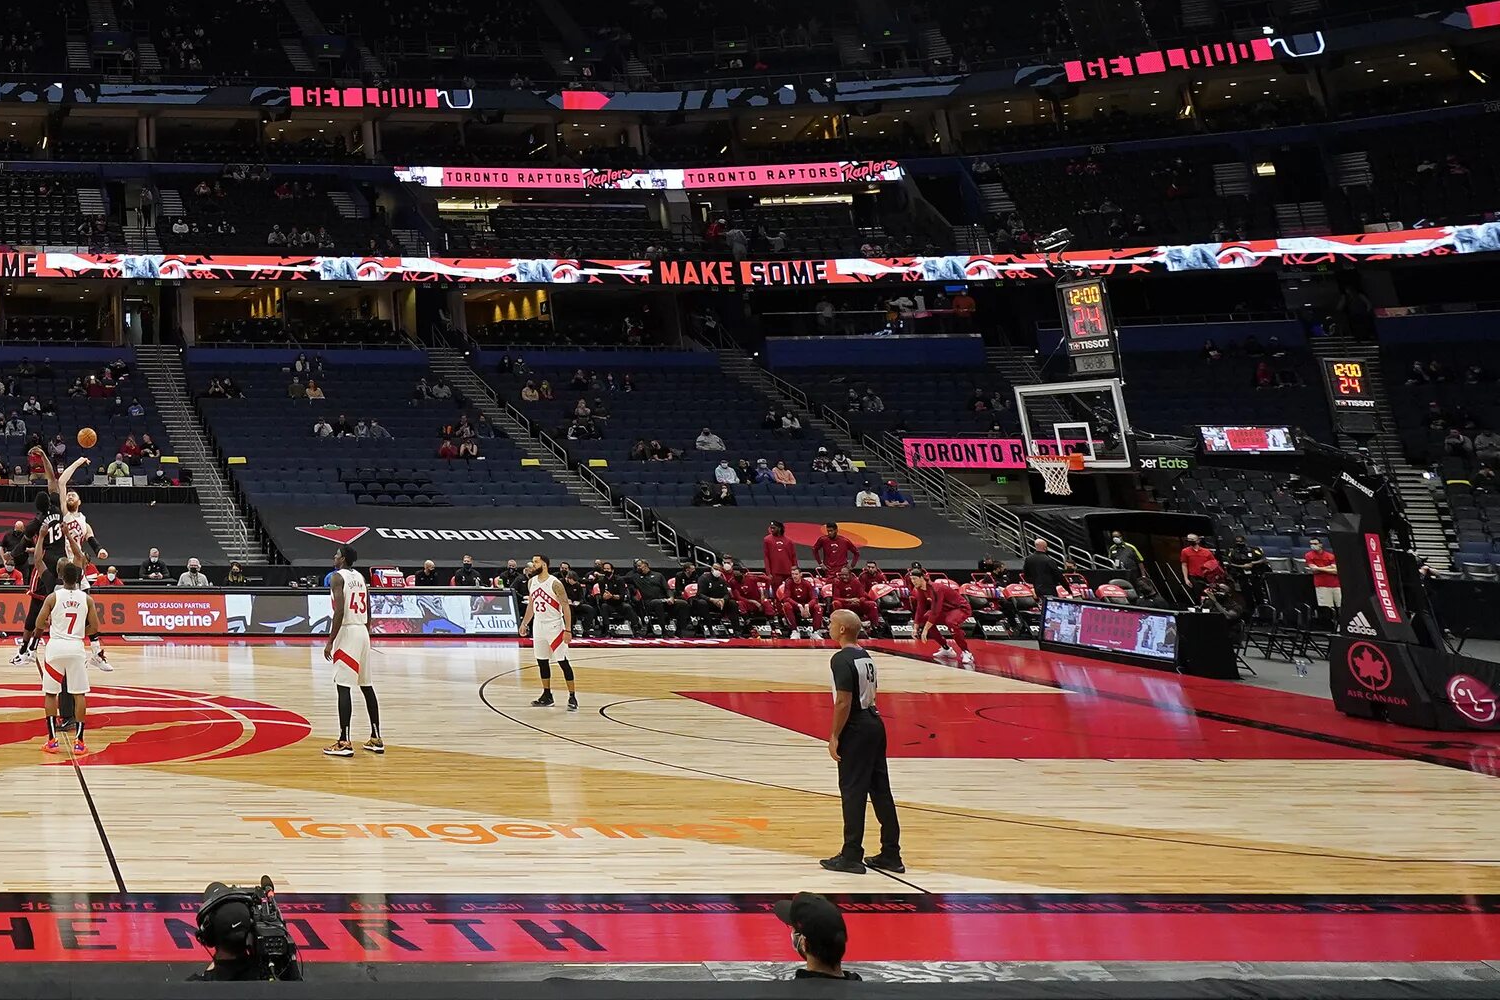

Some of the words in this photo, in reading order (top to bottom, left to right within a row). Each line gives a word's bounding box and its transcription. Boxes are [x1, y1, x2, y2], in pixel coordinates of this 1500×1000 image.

[1082, 55, 1139, 81] GET
[1163, 40, 1256, 70] LOUD
[302, 87, 345, 107] GET
[363, 88, 426, 108] LOUD
[1090, 145, 1106, 155] 205
[445, 172, 509, 183] TORONTO
[517, 172, 581, 184] RAPTORS
[583, 167, 634, 189] Raptors
[687, 170, 757, 184] TORONTO
[766, 165, 838, 181] RAPTORS
[841, 159, 898, 182] Raptors
[660, 261, 736, 285] MAKE
[750, 261, 828, 285] SOME
[1069, 286, 1101, 305] 12:00
[1073, 307, 1102, 336] 24
[1080, 338, 1110, 350] TISSOT
[1333, 363, 1361, 378] 12:00
[1338, 377, 1361, 394] 24
[1347, 399, 1375, 408] TISSOT
[910, 442, 1003, 463] TORONTO
[1158, 456, 1189, 469] Eats
[1340, 471, 1375, 498] SPALDING
[47, 525, 63, 544] 13
[375, 527, 541, 542] CANADIAN
[542, 528, 620, 541] TIRE
[1372, 552, 1398, 620] BIOSTEEL
[349, 592, 367, 614] 43
[535, 601, 547, 612] 23
[64, 612, 77, 635] 7
[138, 610, 213, 630] Tangerine
[474, 616, 486, 629] A
[1347, 624, 1377, 636] adidas
[1347, 689, 1364, 699] AIR
[1365, 690, 1408, 707] CANADA
[242, 816, 742, 845] Tangerine
[73, 901, 157, 910] NORTE
